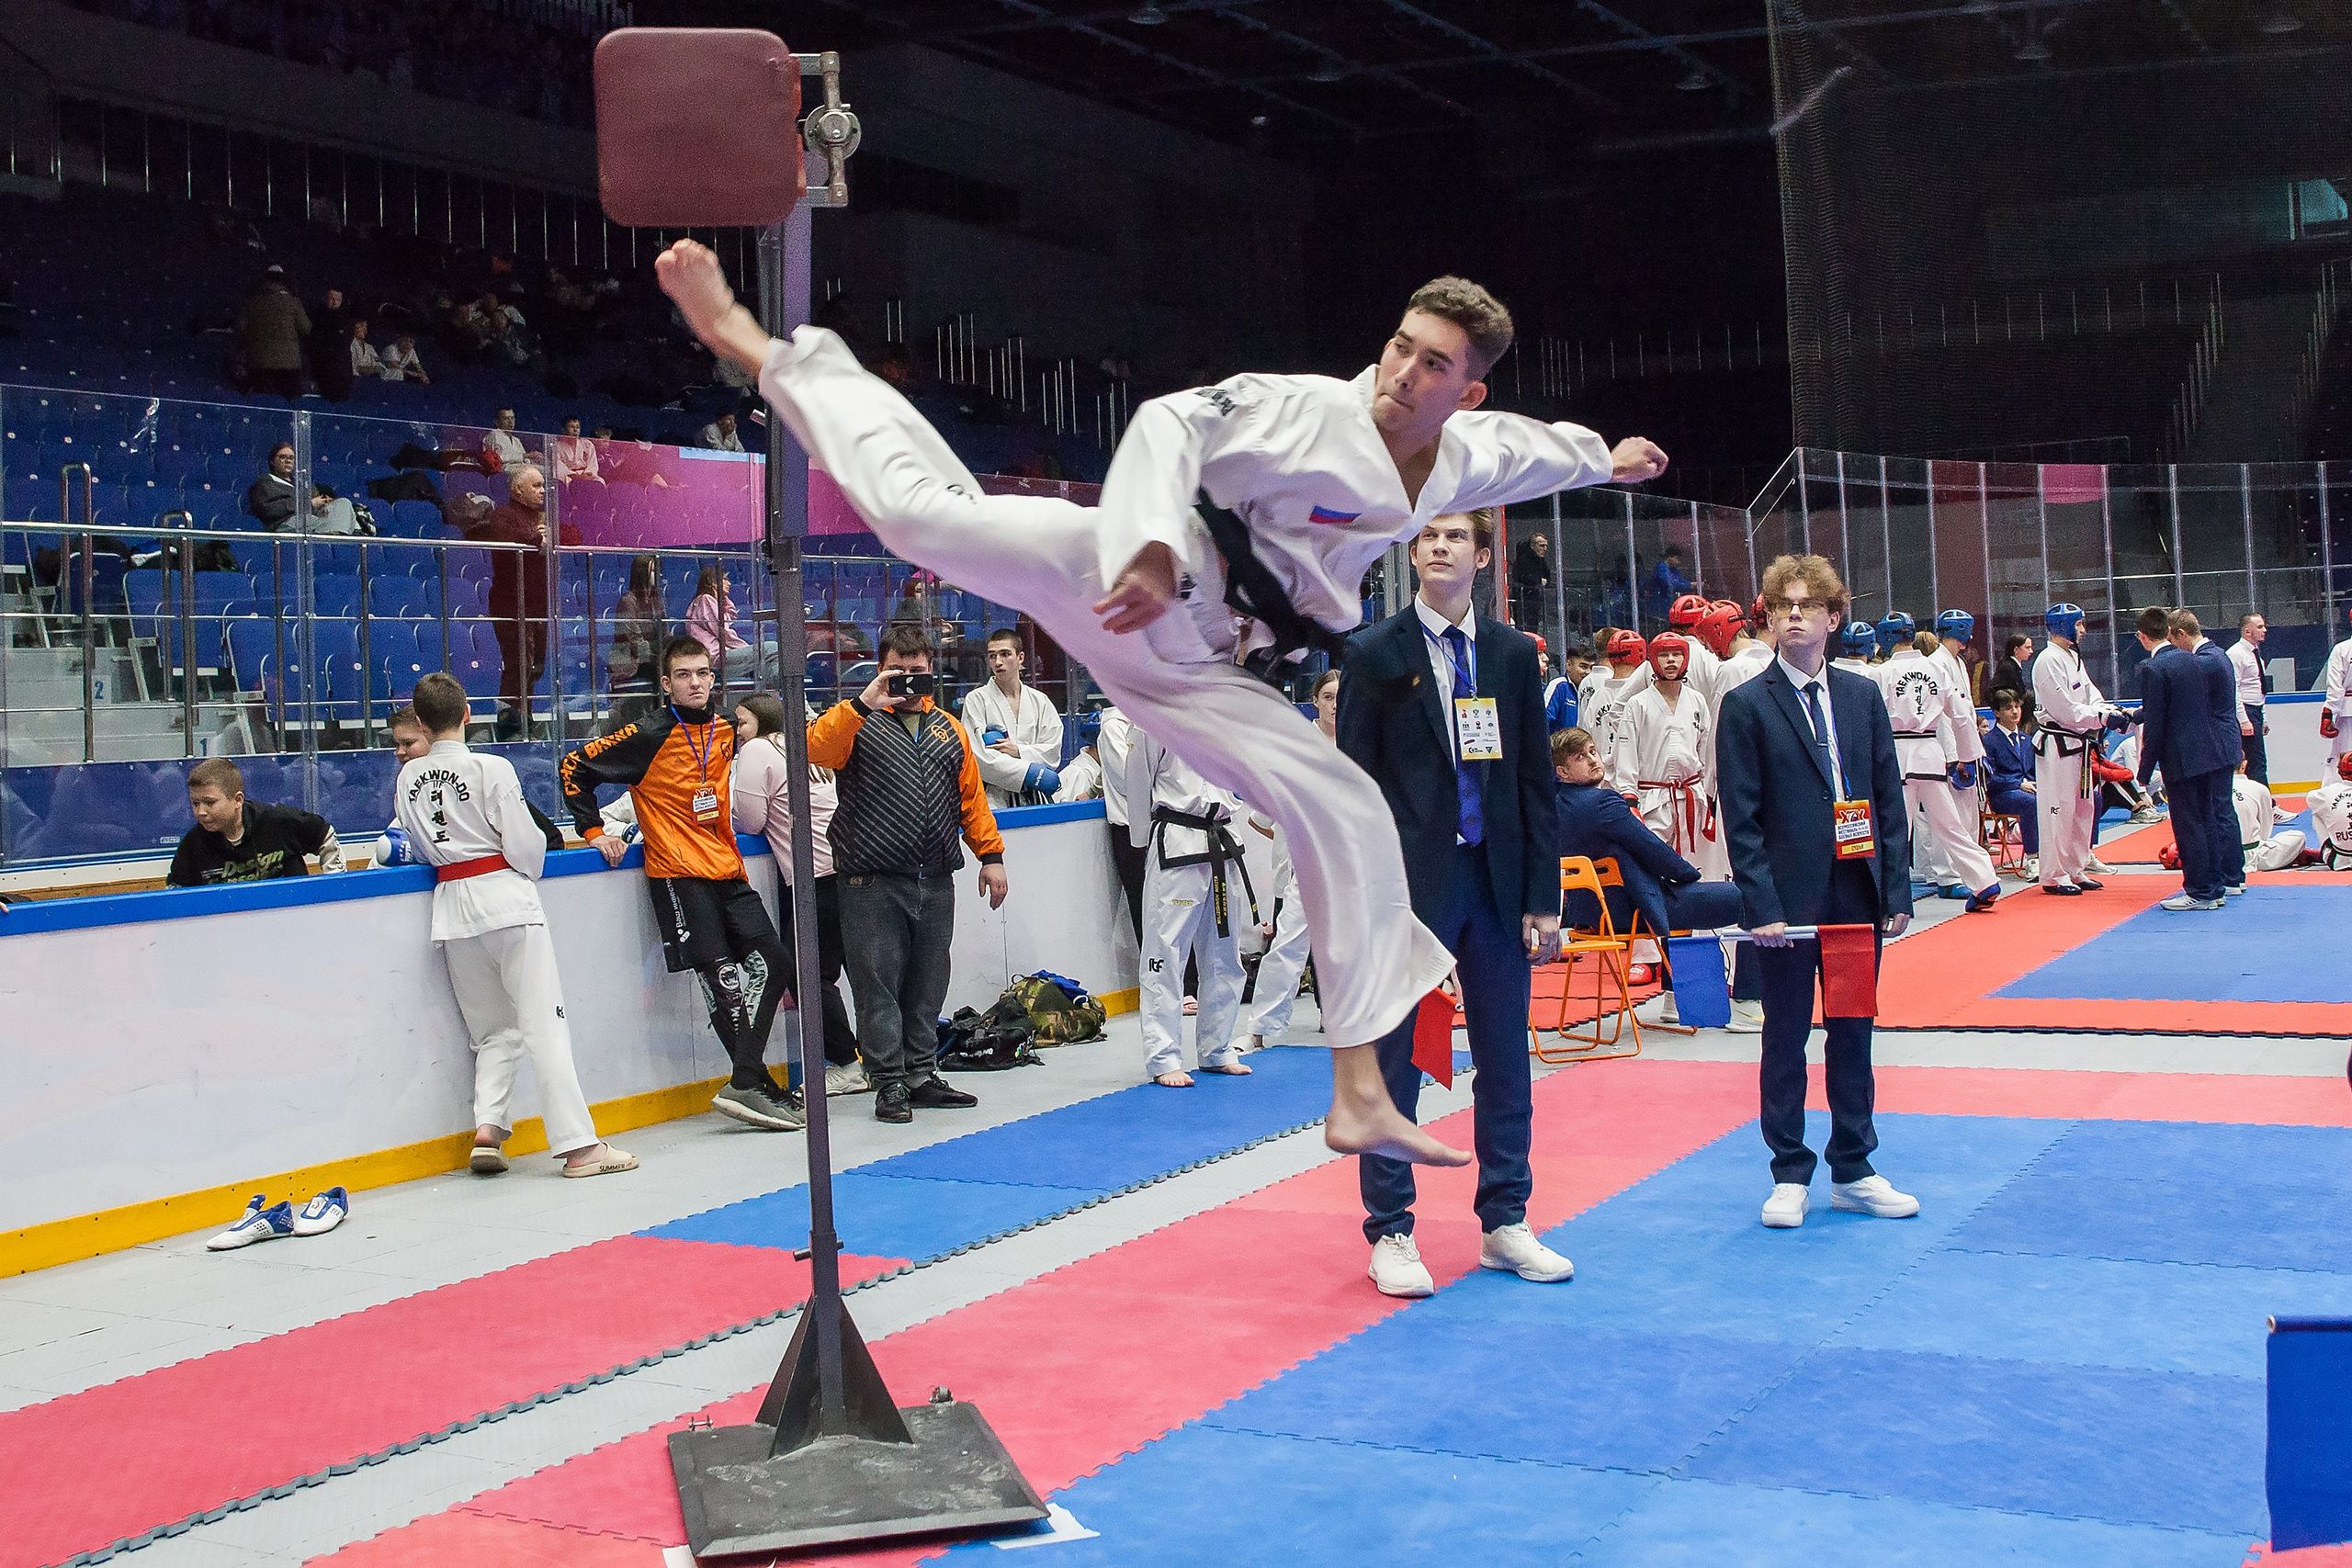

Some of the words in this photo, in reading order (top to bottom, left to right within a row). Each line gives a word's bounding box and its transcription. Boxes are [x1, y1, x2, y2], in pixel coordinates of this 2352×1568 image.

[95, 681, 104, 700] 2
[1895, 671, 1938, 697] TAEKWON-DO
[409, 769, 469, 804] TAEKWON-DO
[666, 877, 678, 910] инвесто
[599, 1163, 626, 1173] SUMMER
